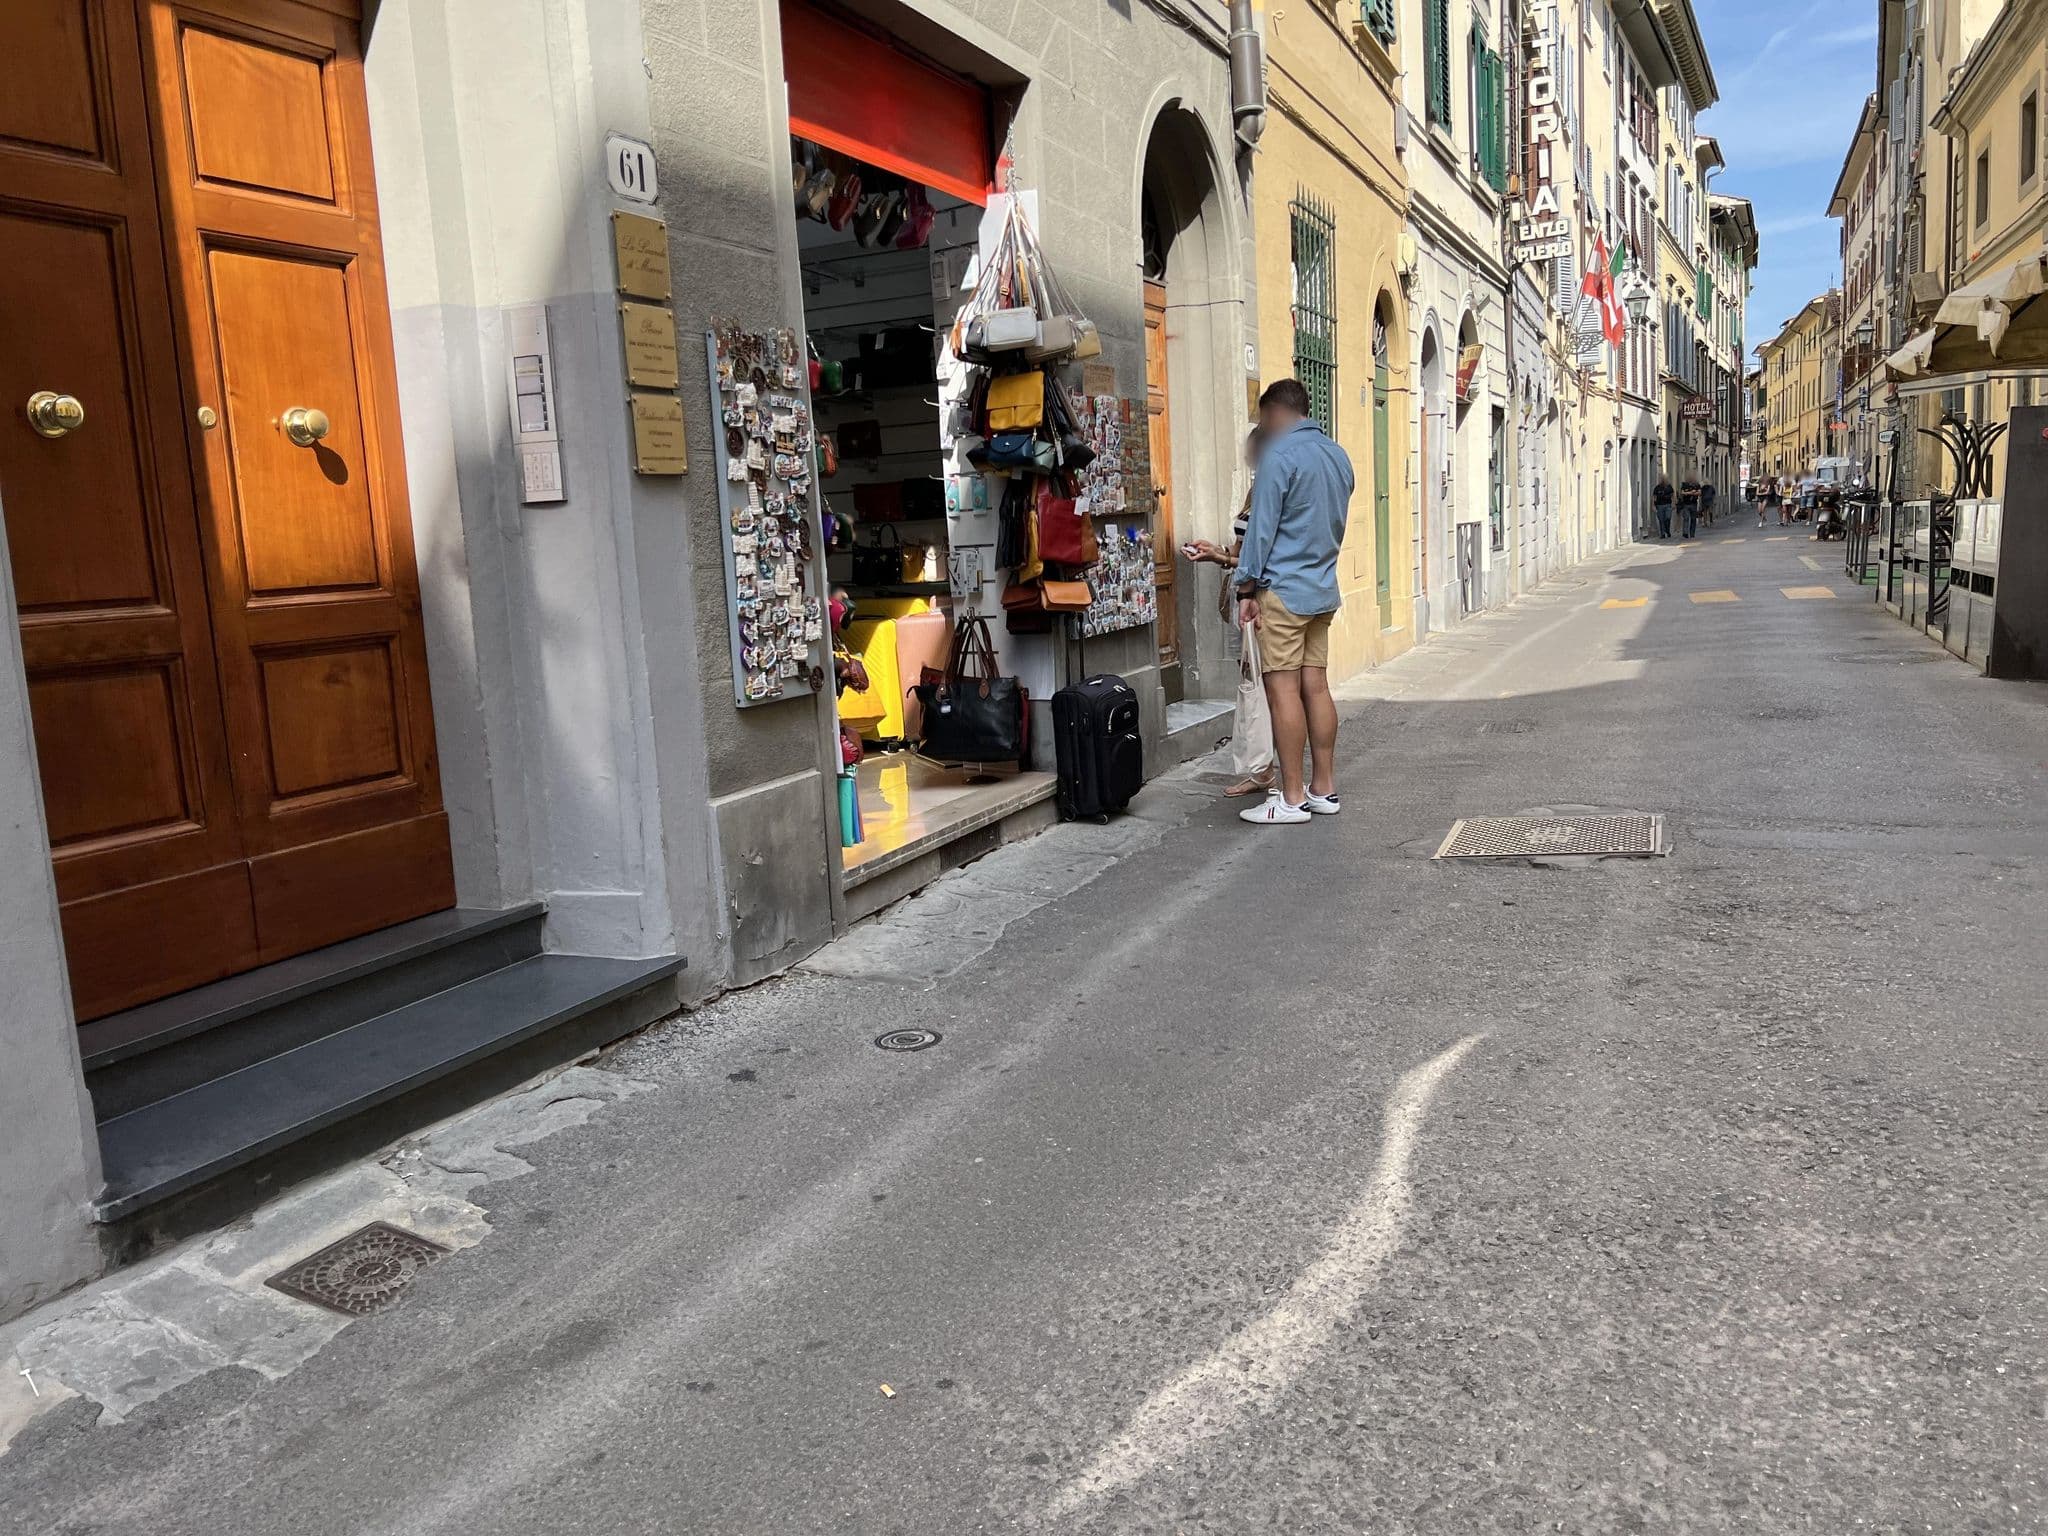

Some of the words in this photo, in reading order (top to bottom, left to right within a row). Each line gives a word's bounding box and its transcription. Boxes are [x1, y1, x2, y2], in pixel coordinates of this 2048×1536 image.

[620, 148, 645, 192] 61
[1519, 219, 1568, 241] ENZO
[1517, 241, 1572, 263] PIERO
[1684, 402, 1711, 412] HOTEL
